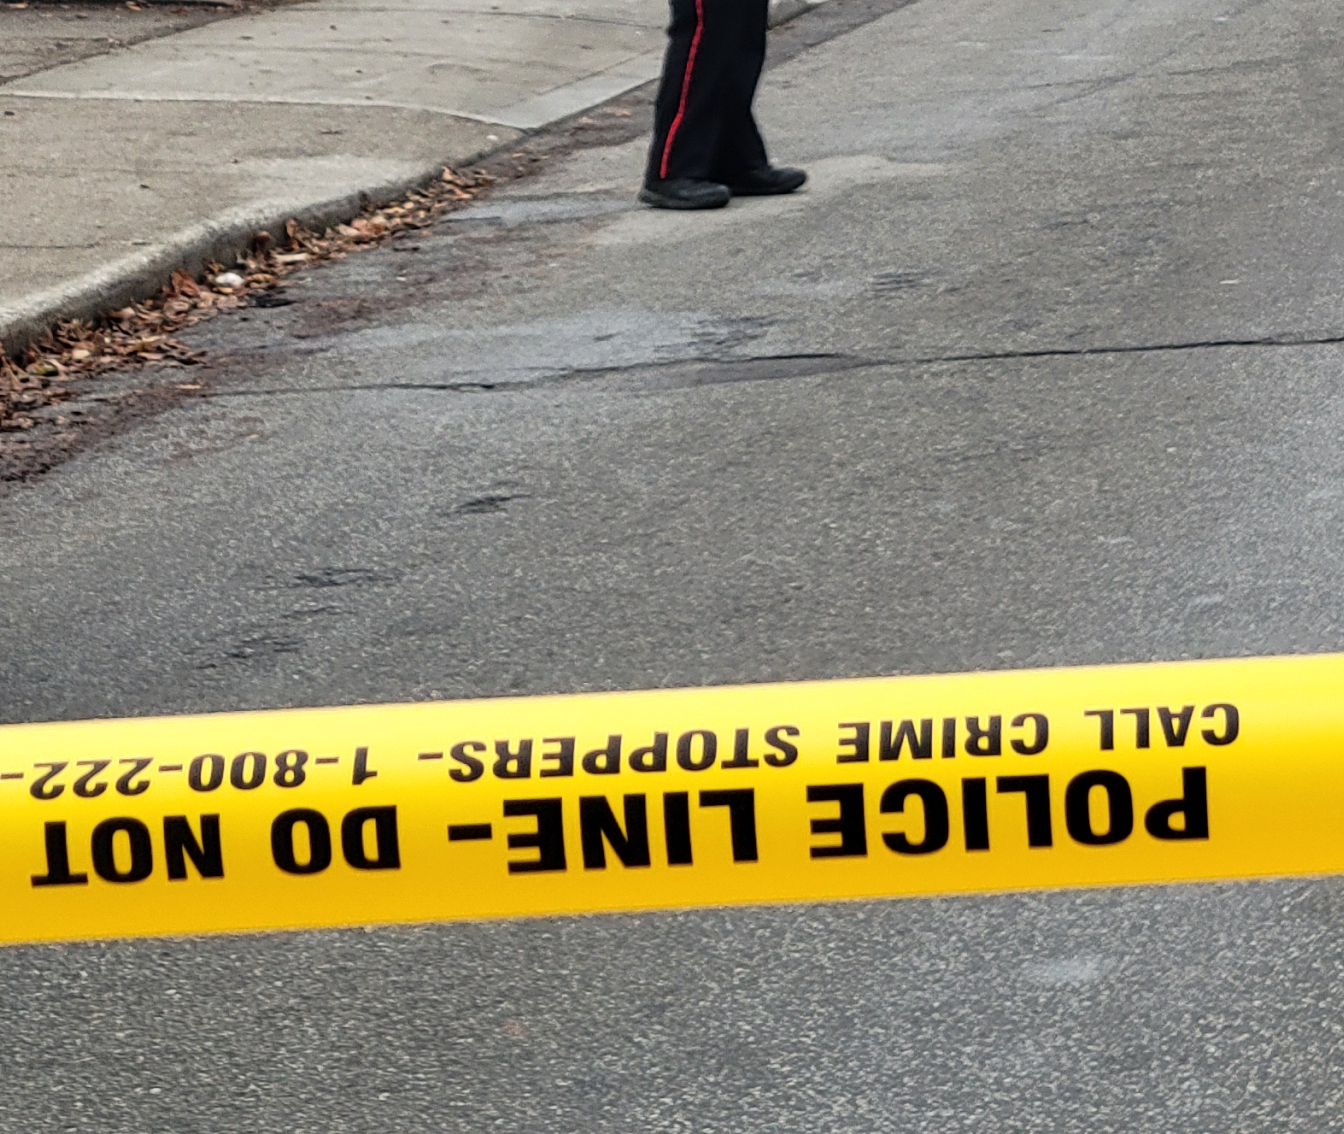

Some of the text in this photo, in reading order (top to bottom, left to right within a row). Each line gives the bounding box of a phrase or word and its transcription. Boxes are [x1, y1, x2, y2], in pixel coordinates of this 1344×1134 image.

[836, 713, 1049, 764] CRIME
[1086, 703, 1239, 751] CALL
[270, 805, 401, 876] DO
[806, 766, 1210, 859] POLICE
[30, 814, 225, 887] NOT
